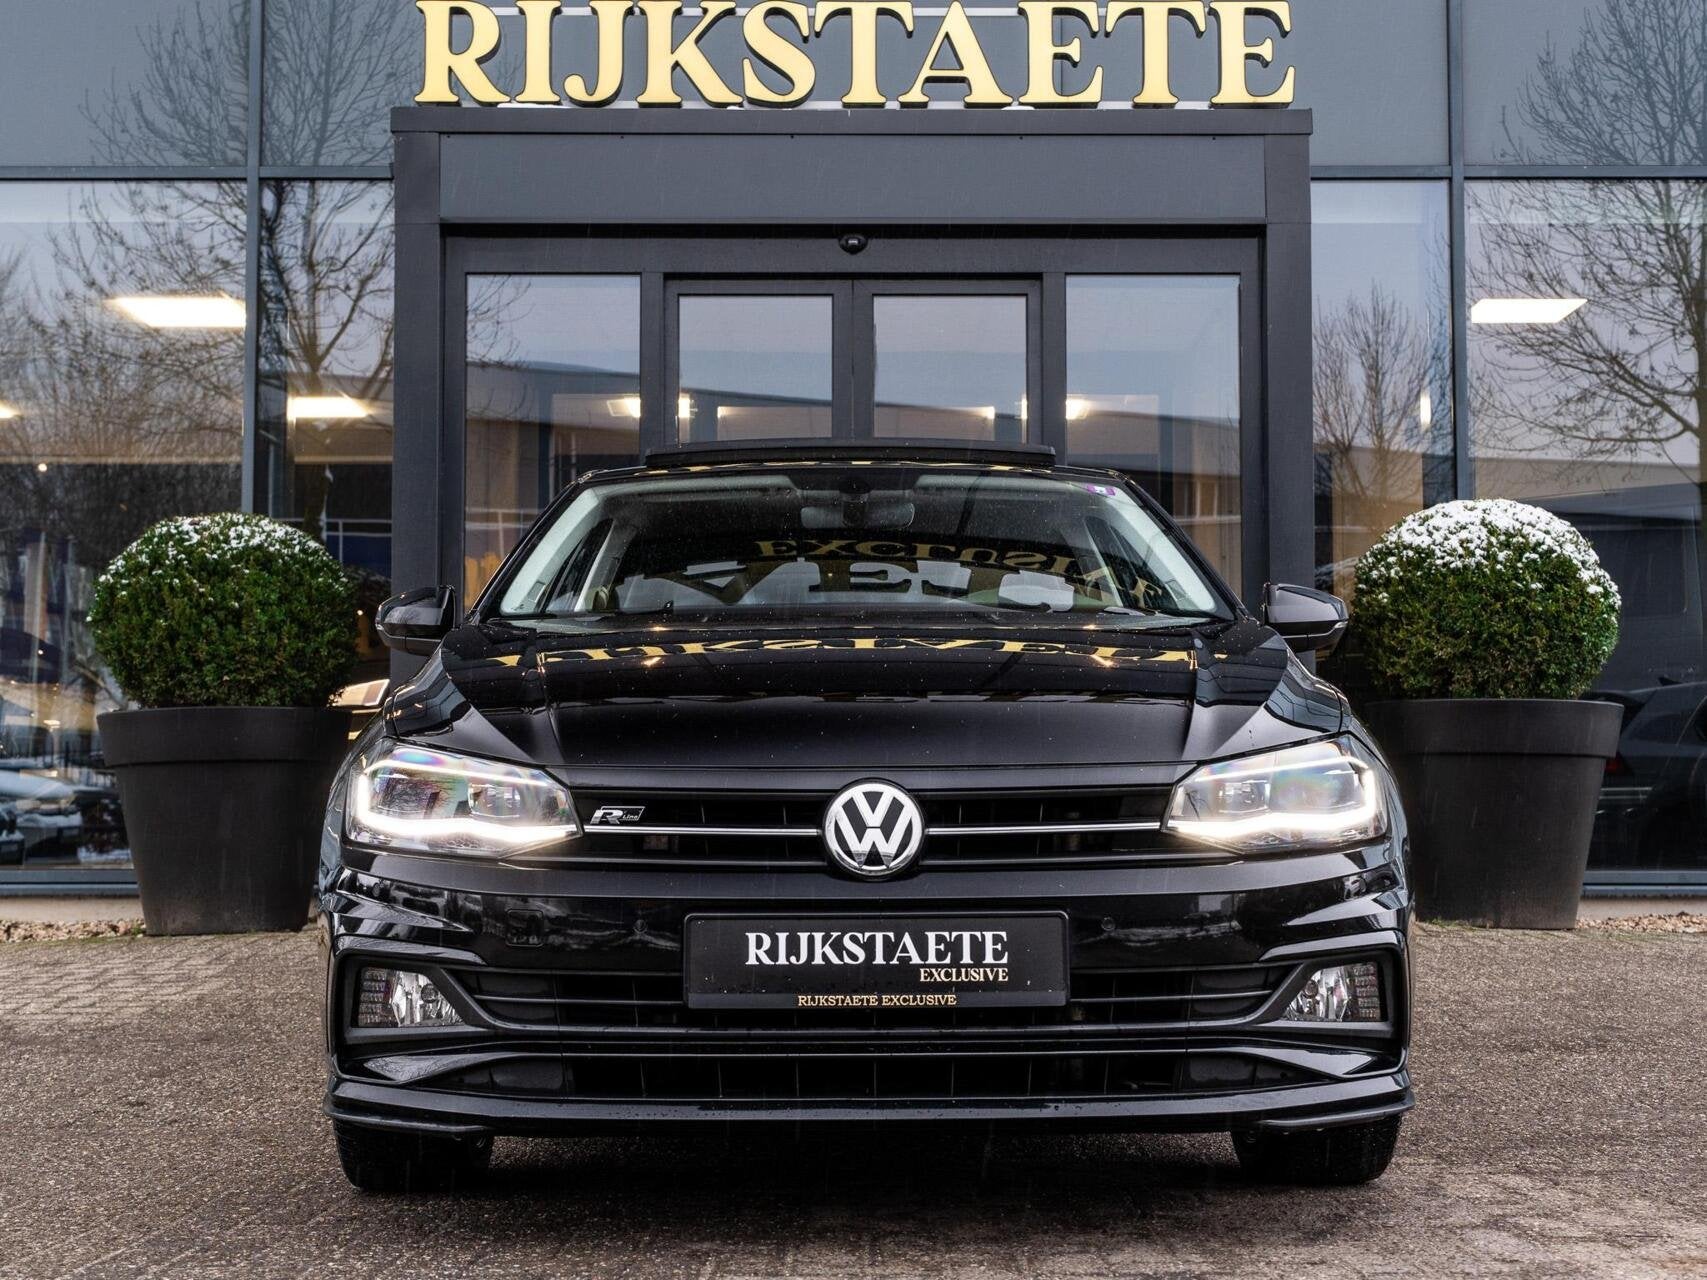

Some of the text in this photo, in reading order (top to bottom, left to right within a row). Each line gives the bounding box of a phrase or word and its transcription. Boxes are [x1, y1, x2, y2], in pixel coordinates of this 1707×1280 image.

[416, 0, 1296, 108] RIJKSTAETE
[745, 931, 1008, 965] RIJKSTAETE
[919, 968, 1008, 982] EXCLUSIVE
[798, 994, 957, 1006] RIJKSTAETE EXCLUSIVE
